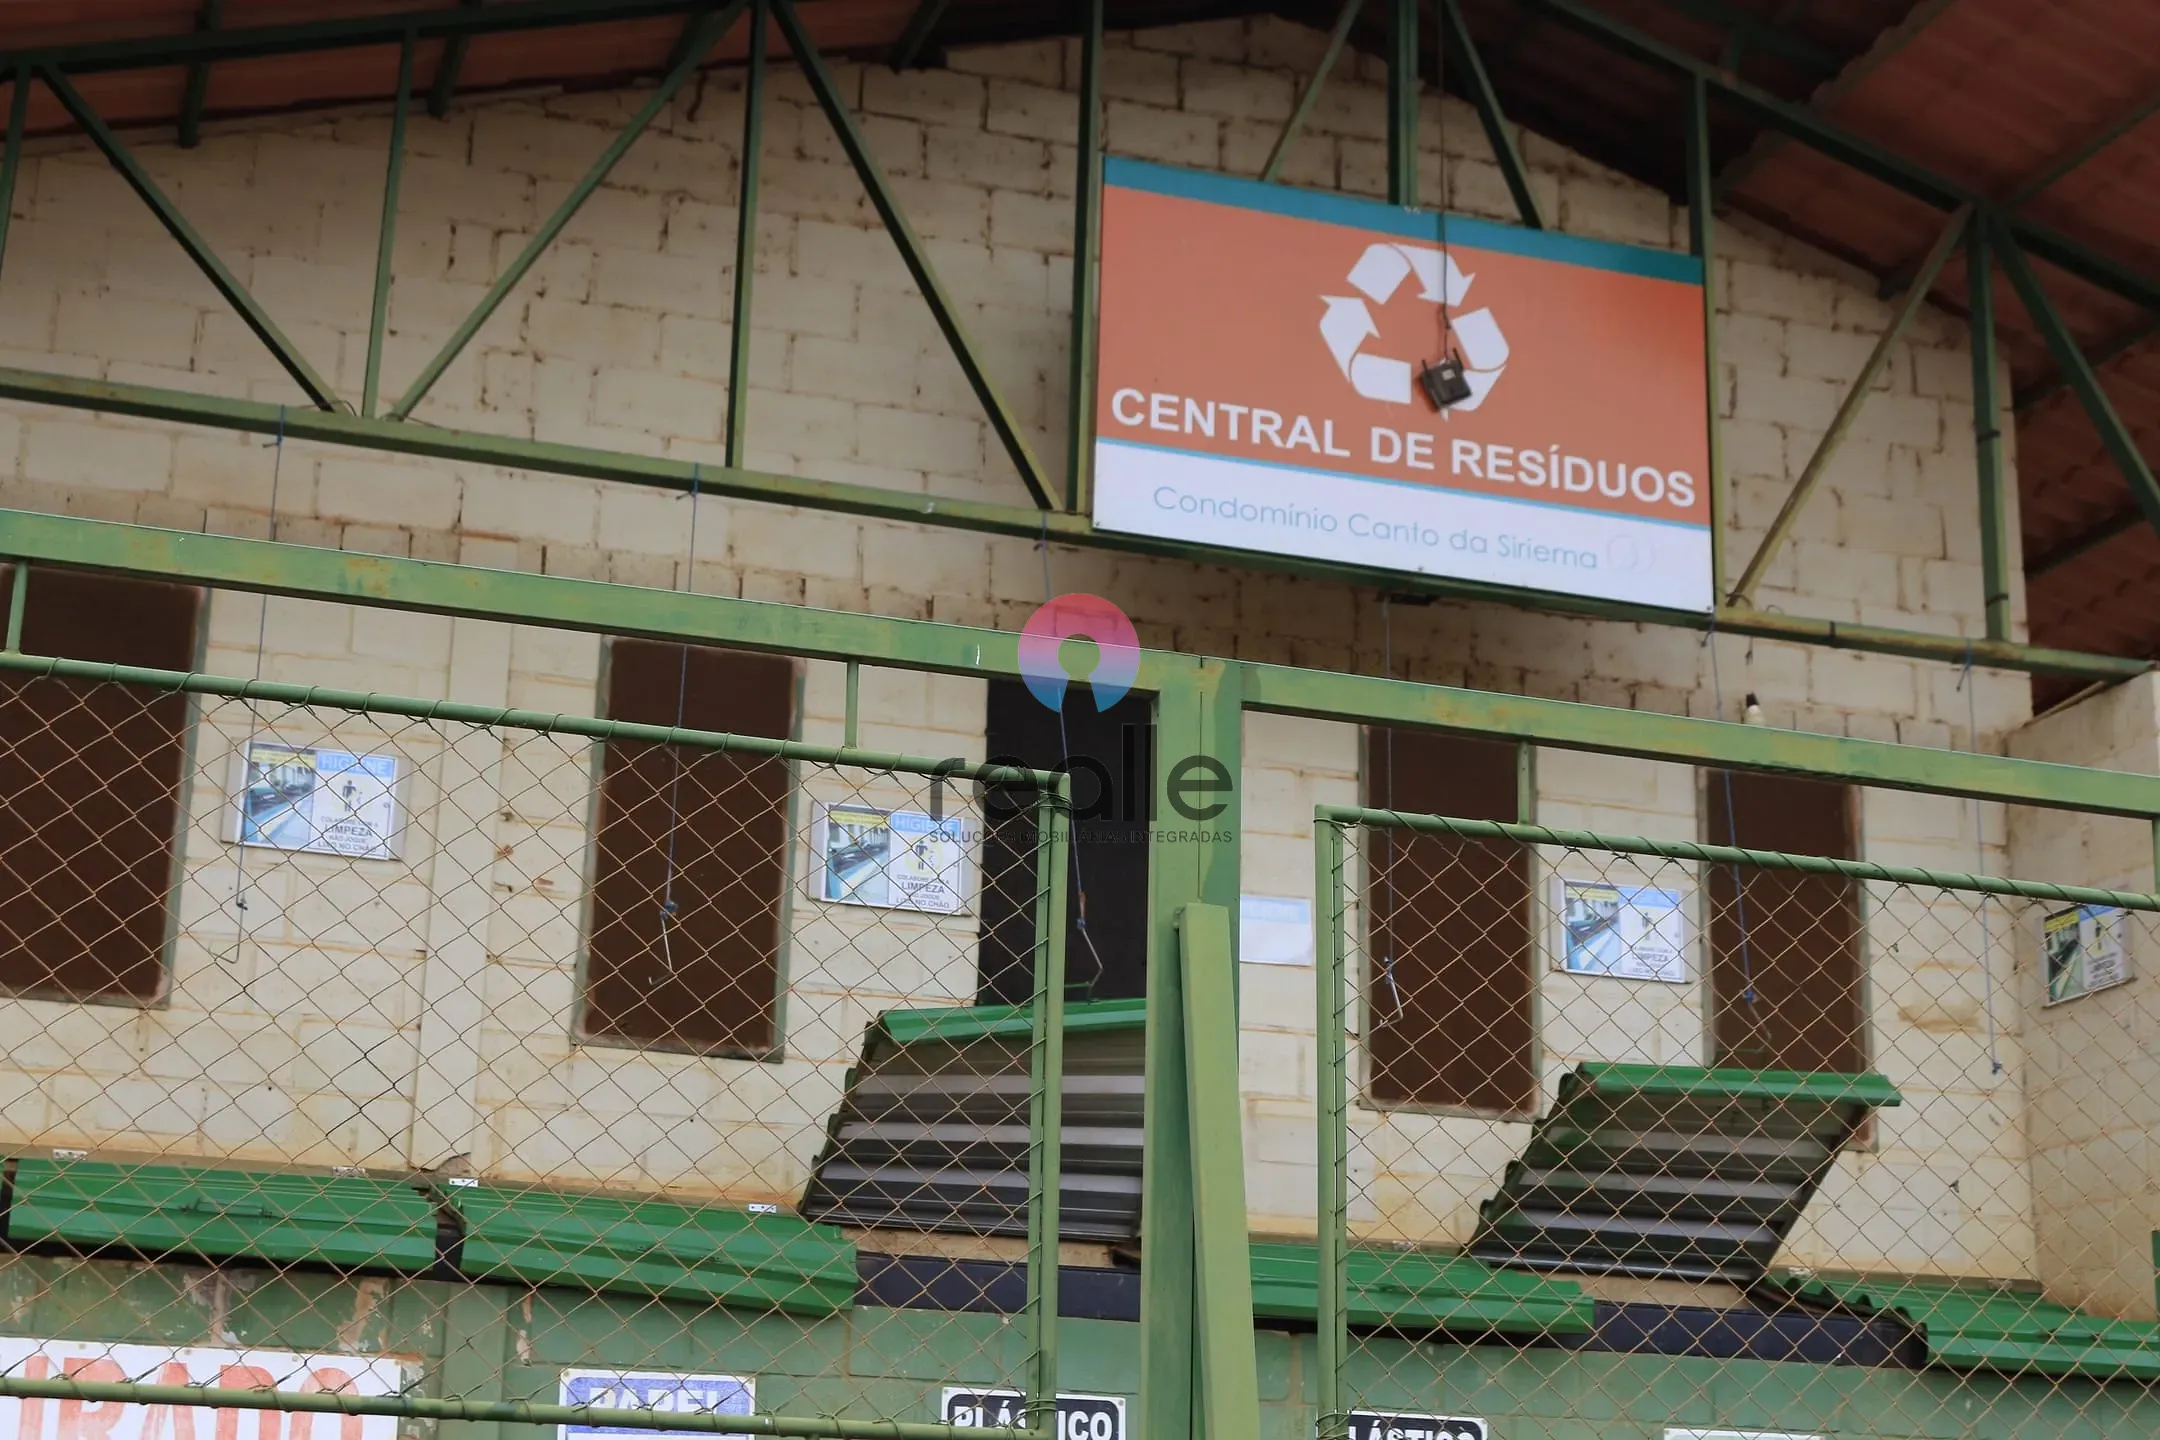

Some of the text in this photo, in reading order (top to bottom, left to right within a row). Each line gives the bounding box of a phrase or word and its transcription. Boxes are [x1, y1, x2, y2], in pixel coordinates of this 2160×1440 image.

[1111, 387, 1696, 508] CENTRAL DE RESÍDUOS
[1153, 485, 1599, 571] Condomínio Canto da Siriema
[895, 817, 955, 834] HIGIEE
[953, 1400, 1113, 1440] PLÁICO
